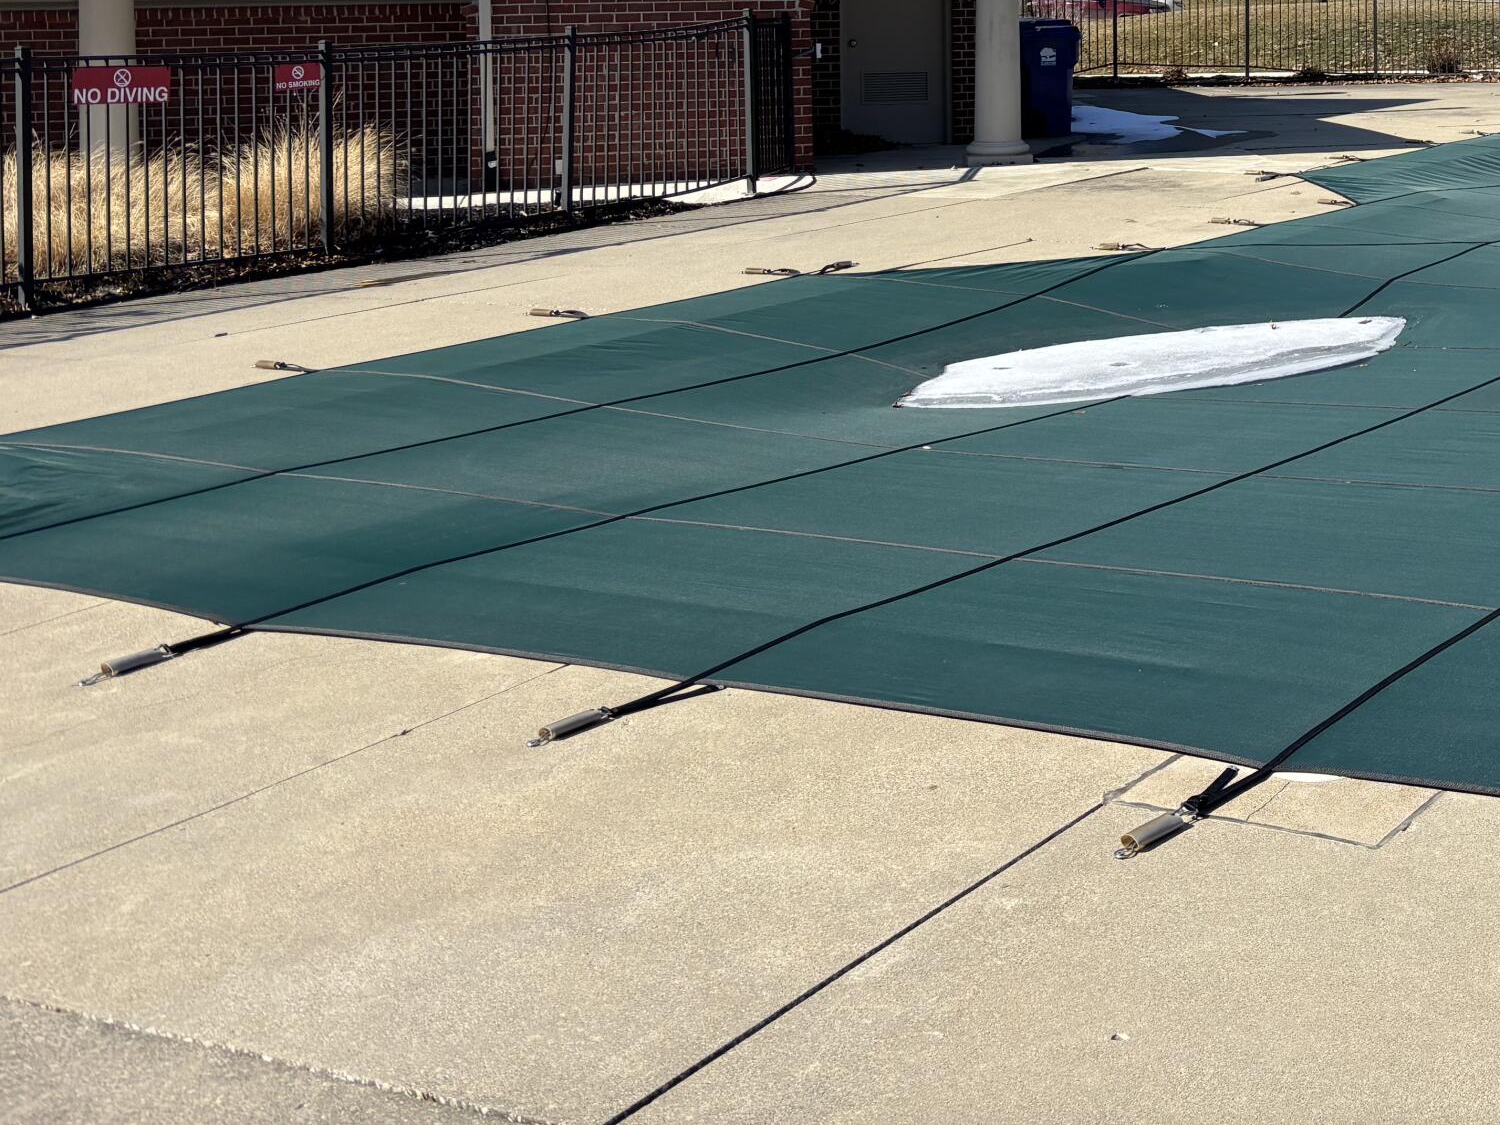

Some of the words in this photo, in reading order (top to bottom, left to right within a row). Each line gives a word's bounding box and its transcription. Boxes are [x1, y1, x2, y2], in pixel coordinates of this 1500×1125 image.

[288, 79, 320, 88] SMOKING
[74, 88, 101, 104] NO
[107, 86, 168, 102] DIVING
